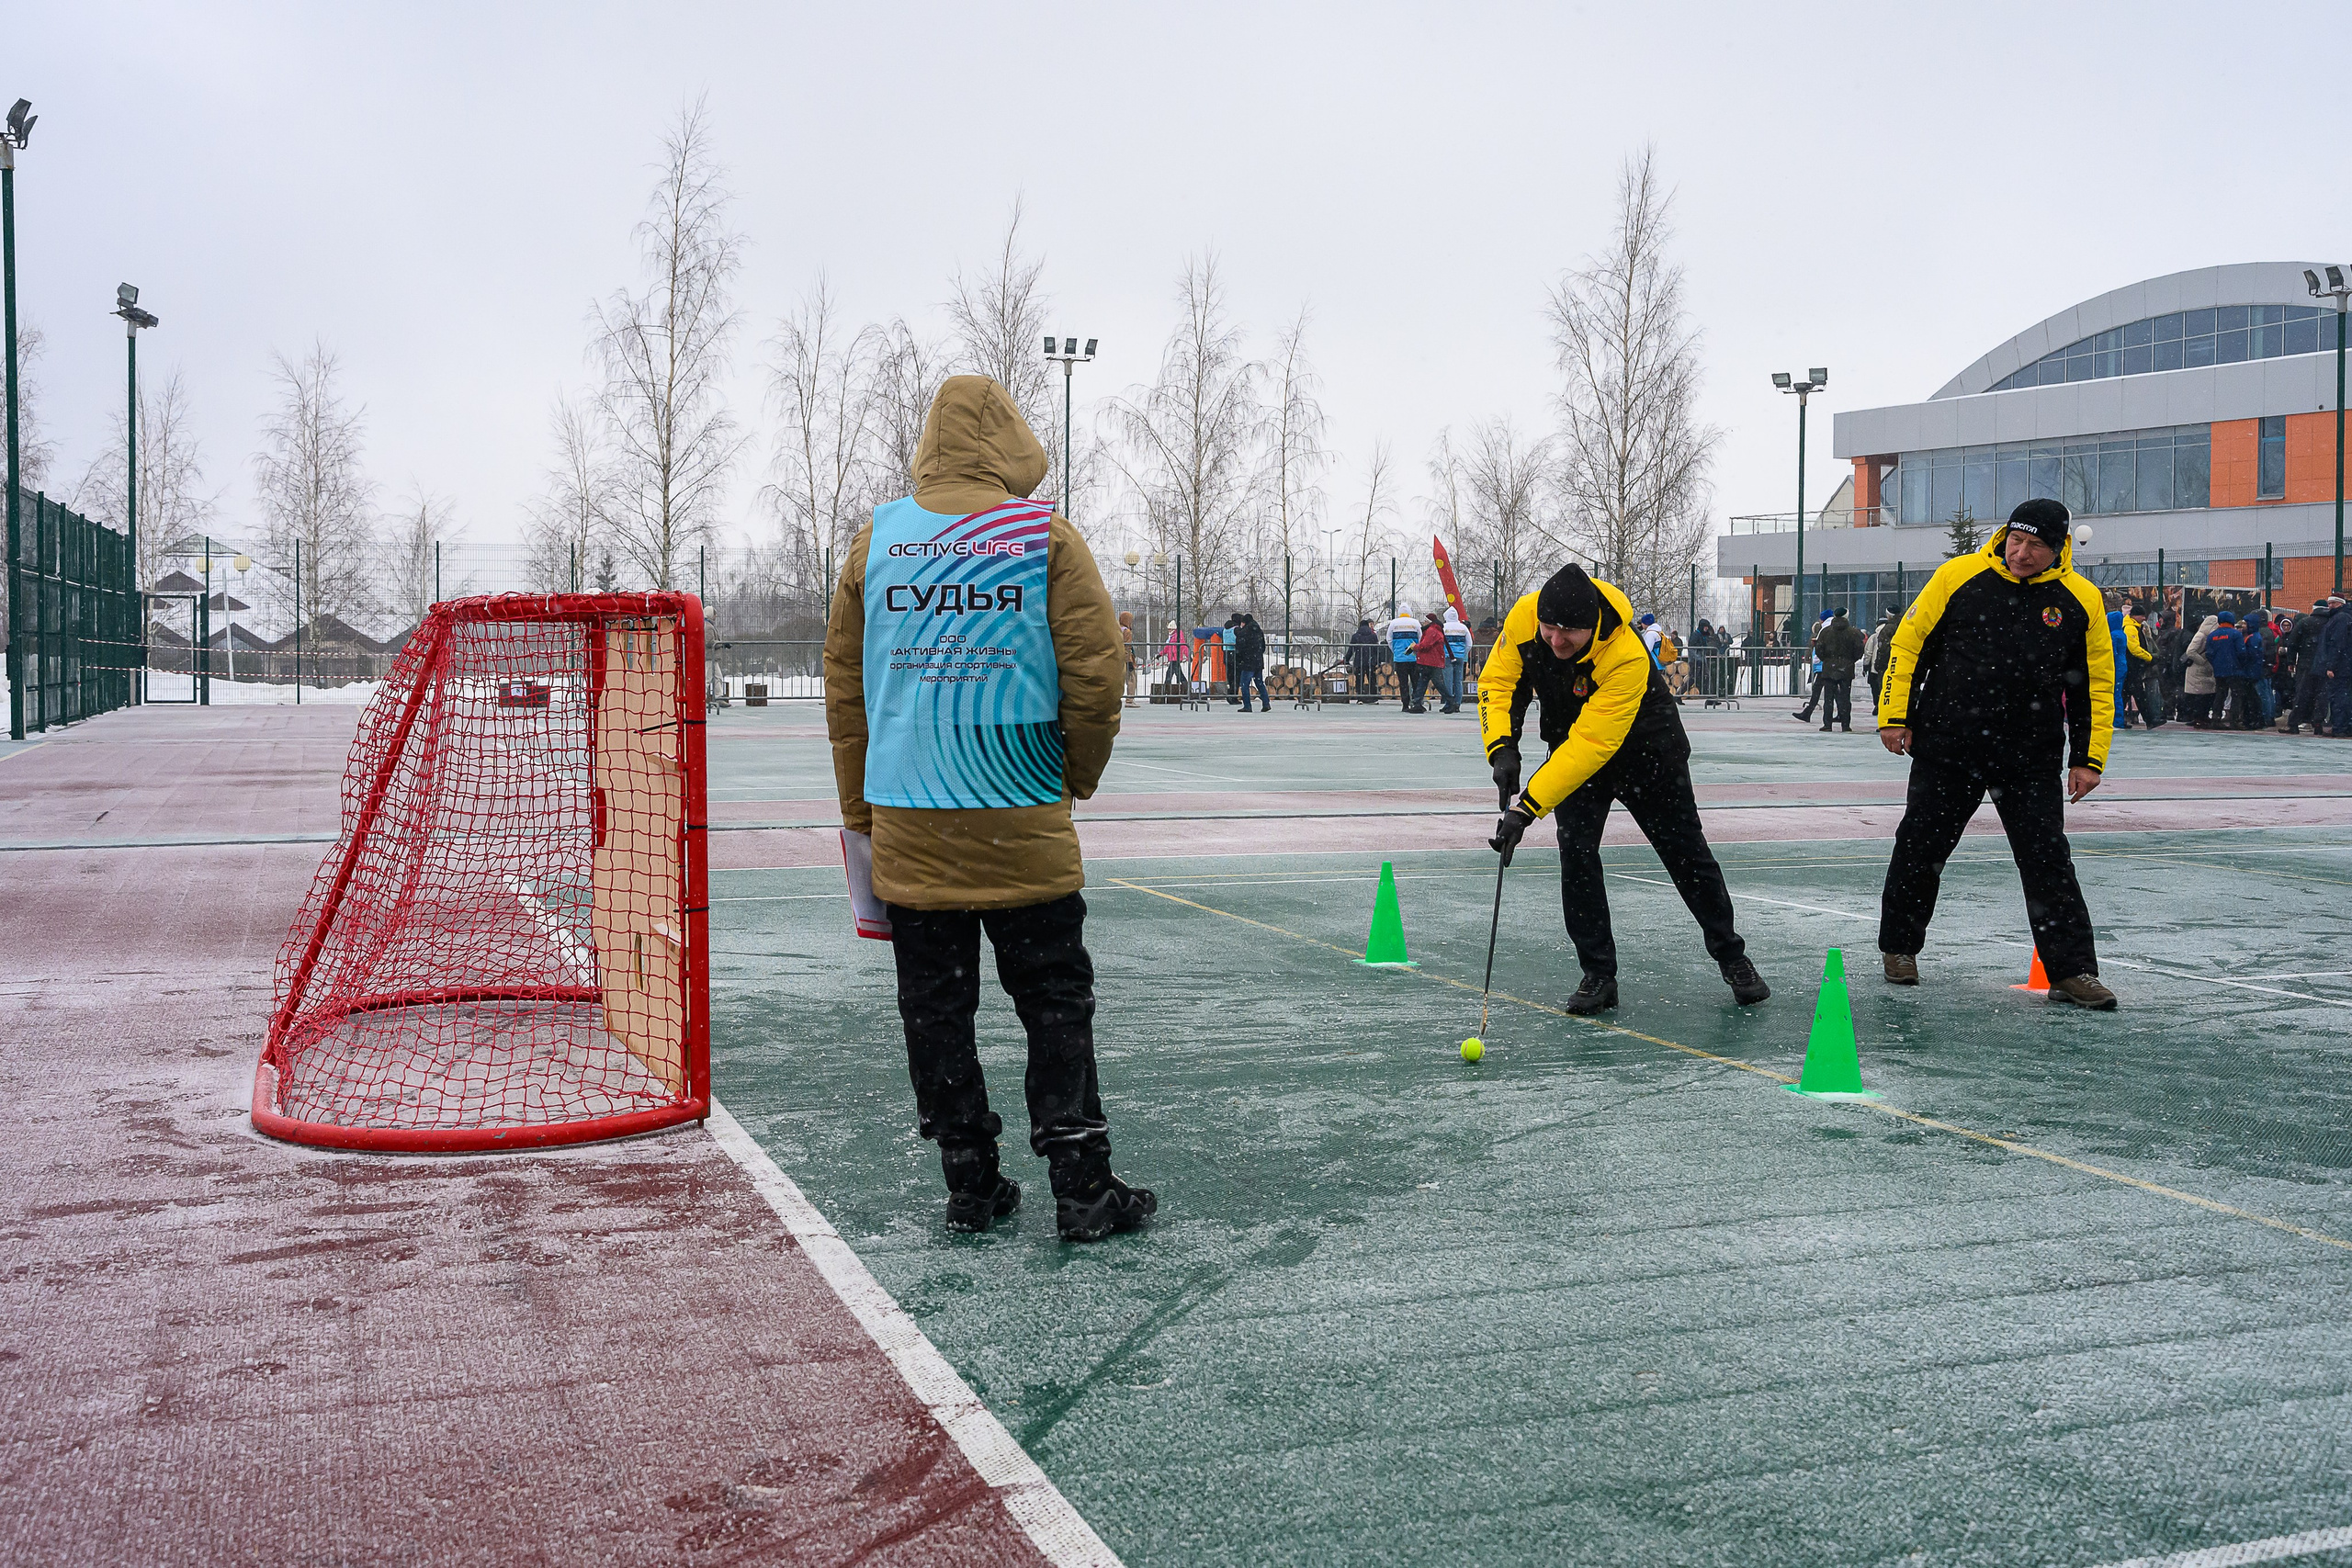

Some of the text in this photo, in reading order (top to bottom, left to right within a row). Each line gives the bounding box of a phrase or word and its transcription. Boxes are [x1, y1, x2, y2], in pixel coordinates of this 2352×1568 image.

[888, 541, 1023, 557] ACTIVE LIFE
[886, 584, 1023, 615] СУДЬЯ
[939, 635, 967, 643] ООО
[890, 647, 1017, 656] «АКТИВНАЯ ЖИЗНЬ»
[889, 661, 1017, 671] организация спортивных
[920, 673, 989, 684] мероприятий
[1481, 691, 1489, 734] BEARUS
